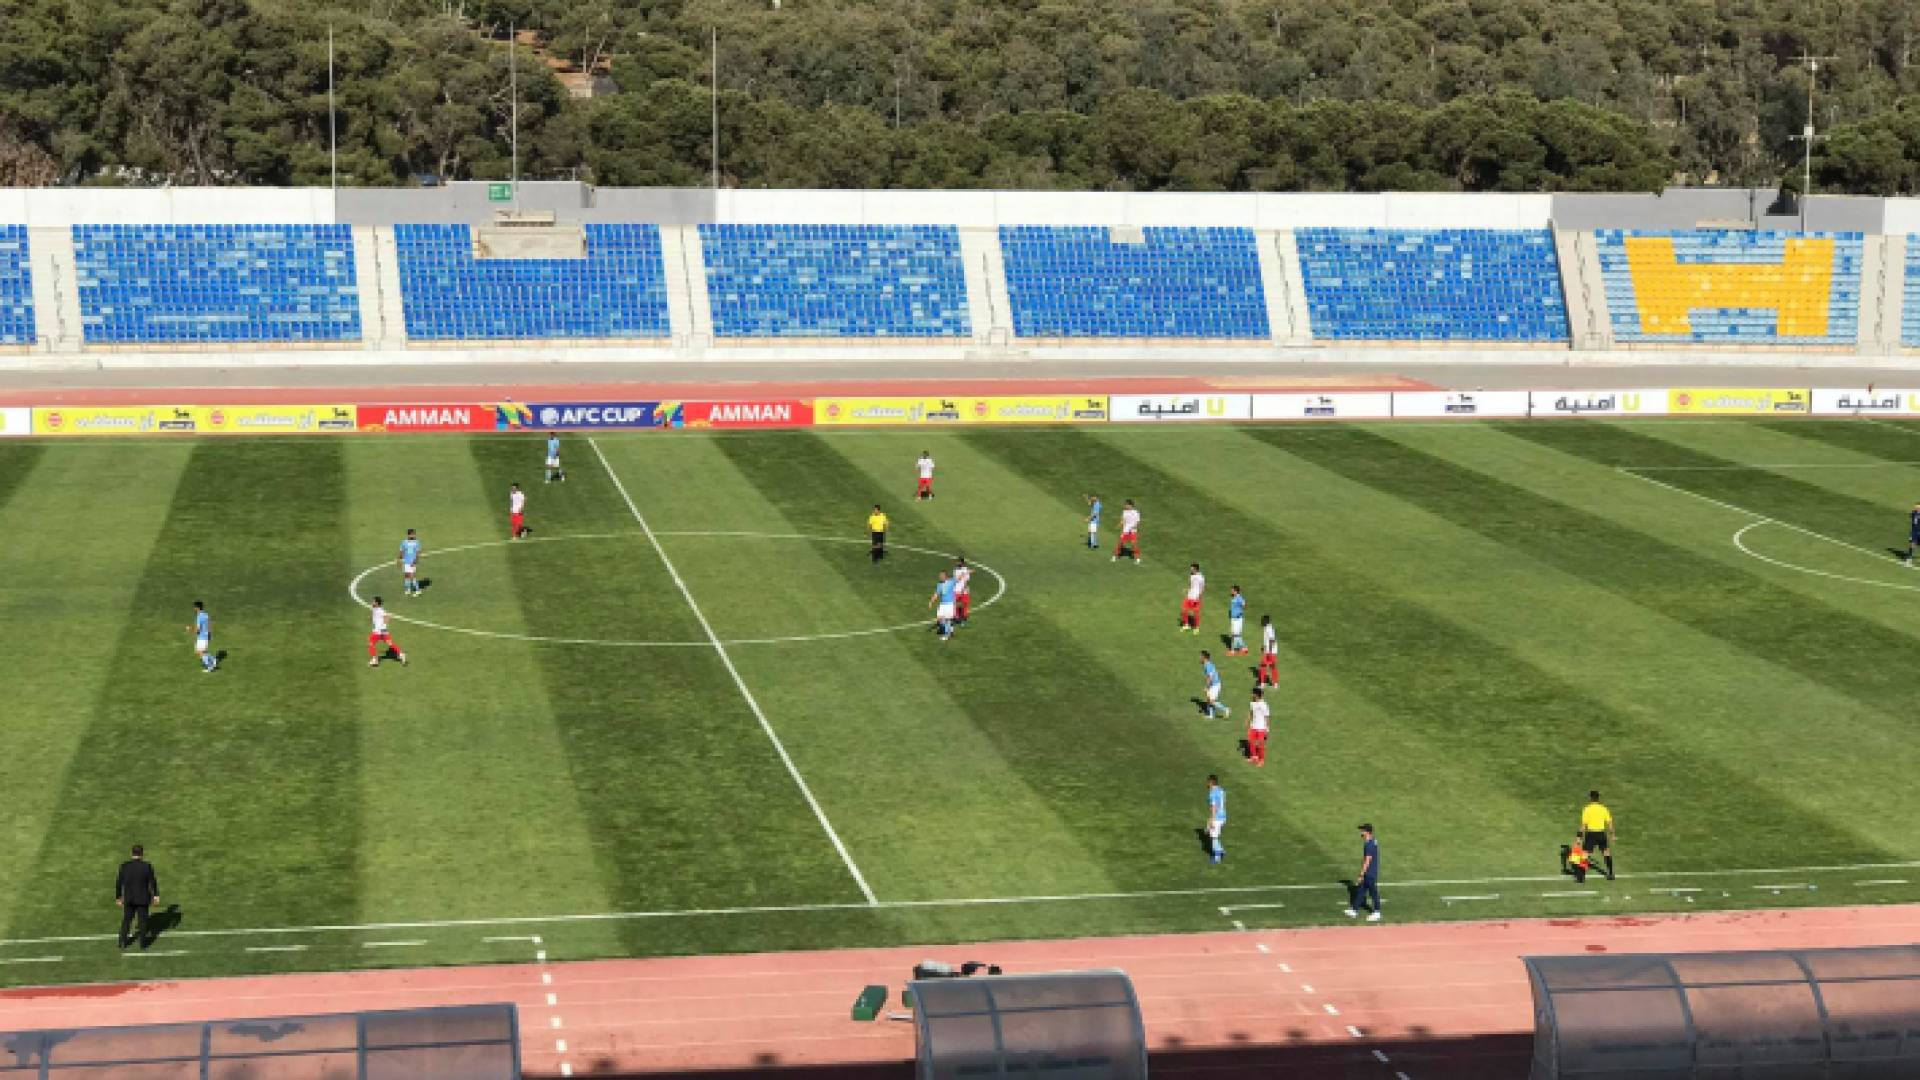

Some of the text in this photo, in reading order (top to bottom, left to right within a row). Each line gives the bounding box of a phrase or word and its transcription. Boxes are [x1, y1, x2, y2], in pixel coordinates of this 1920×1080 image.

[385, 408, 470, 425] AMMAN
[561, 407, 645, 423] AFC CUP
[710, 404, 790, 421] AMMAN
